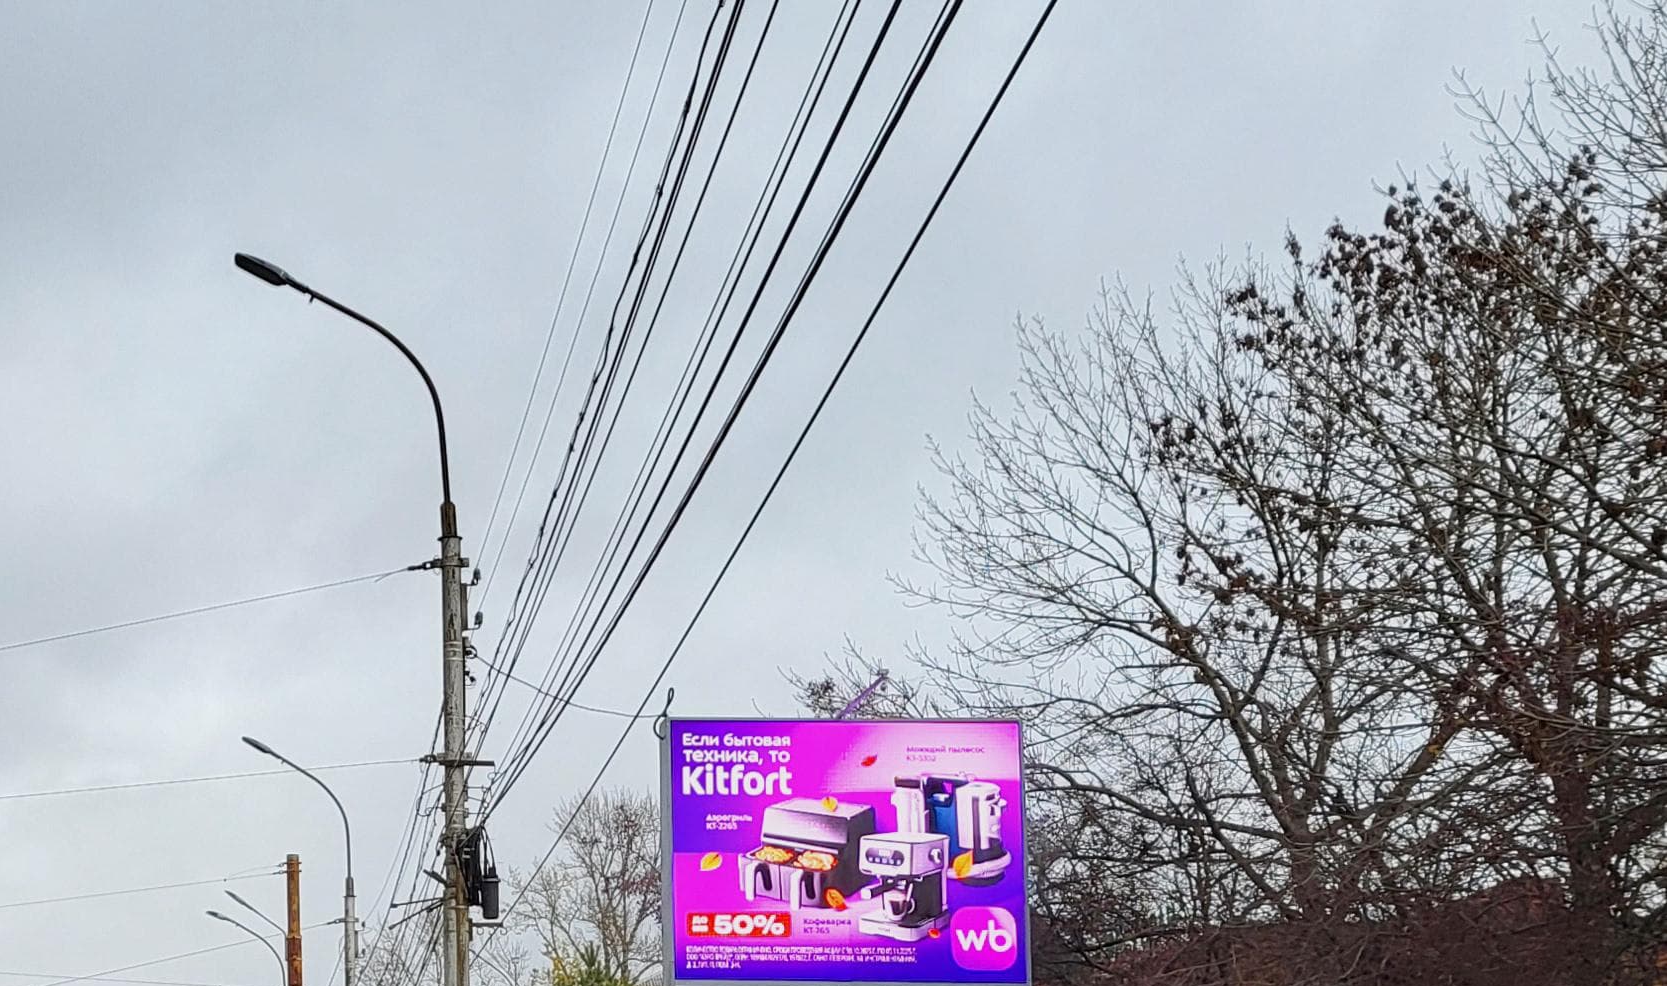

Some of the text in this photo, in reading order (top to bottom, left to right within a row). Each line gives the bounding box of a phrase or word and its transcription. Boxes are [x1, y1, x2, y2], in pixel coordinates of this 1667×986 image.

[682, 733, 791, 746] Если бытовая
[683, 749, 790, 766] техника, то
[682, 763, 793, 796] Kitfort
[955, 920, 1012, 953] wb
